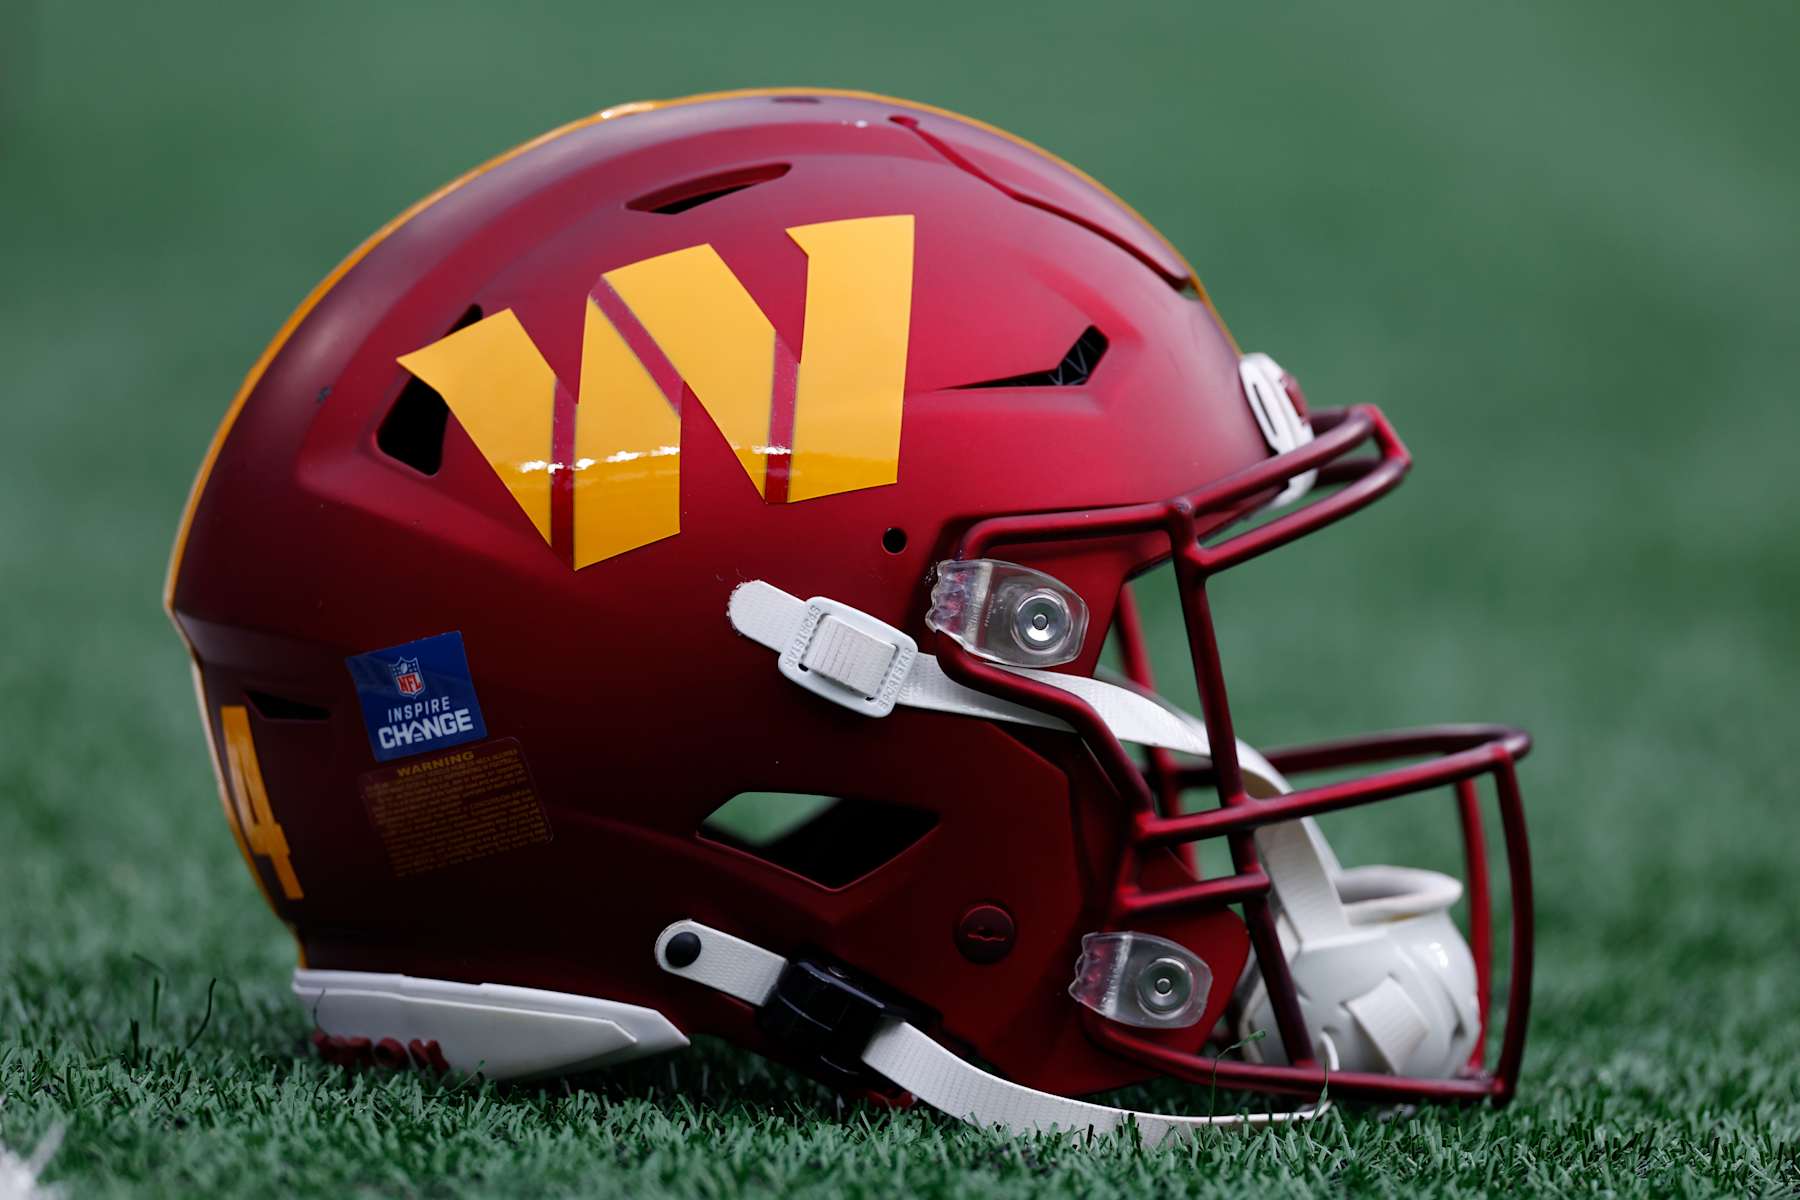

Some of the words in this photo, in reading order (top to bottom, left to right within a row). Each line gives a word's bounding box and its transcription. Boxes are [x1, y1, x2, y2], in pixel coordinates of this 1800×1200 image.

[396, 214, 914, 571] W
[398, 675, 422, 694] NFL
[387, 696, 451, 723] INSPIRE
[377, 707, 475, 750] CHANGE
[395, 750, 475, 777] WARNING
